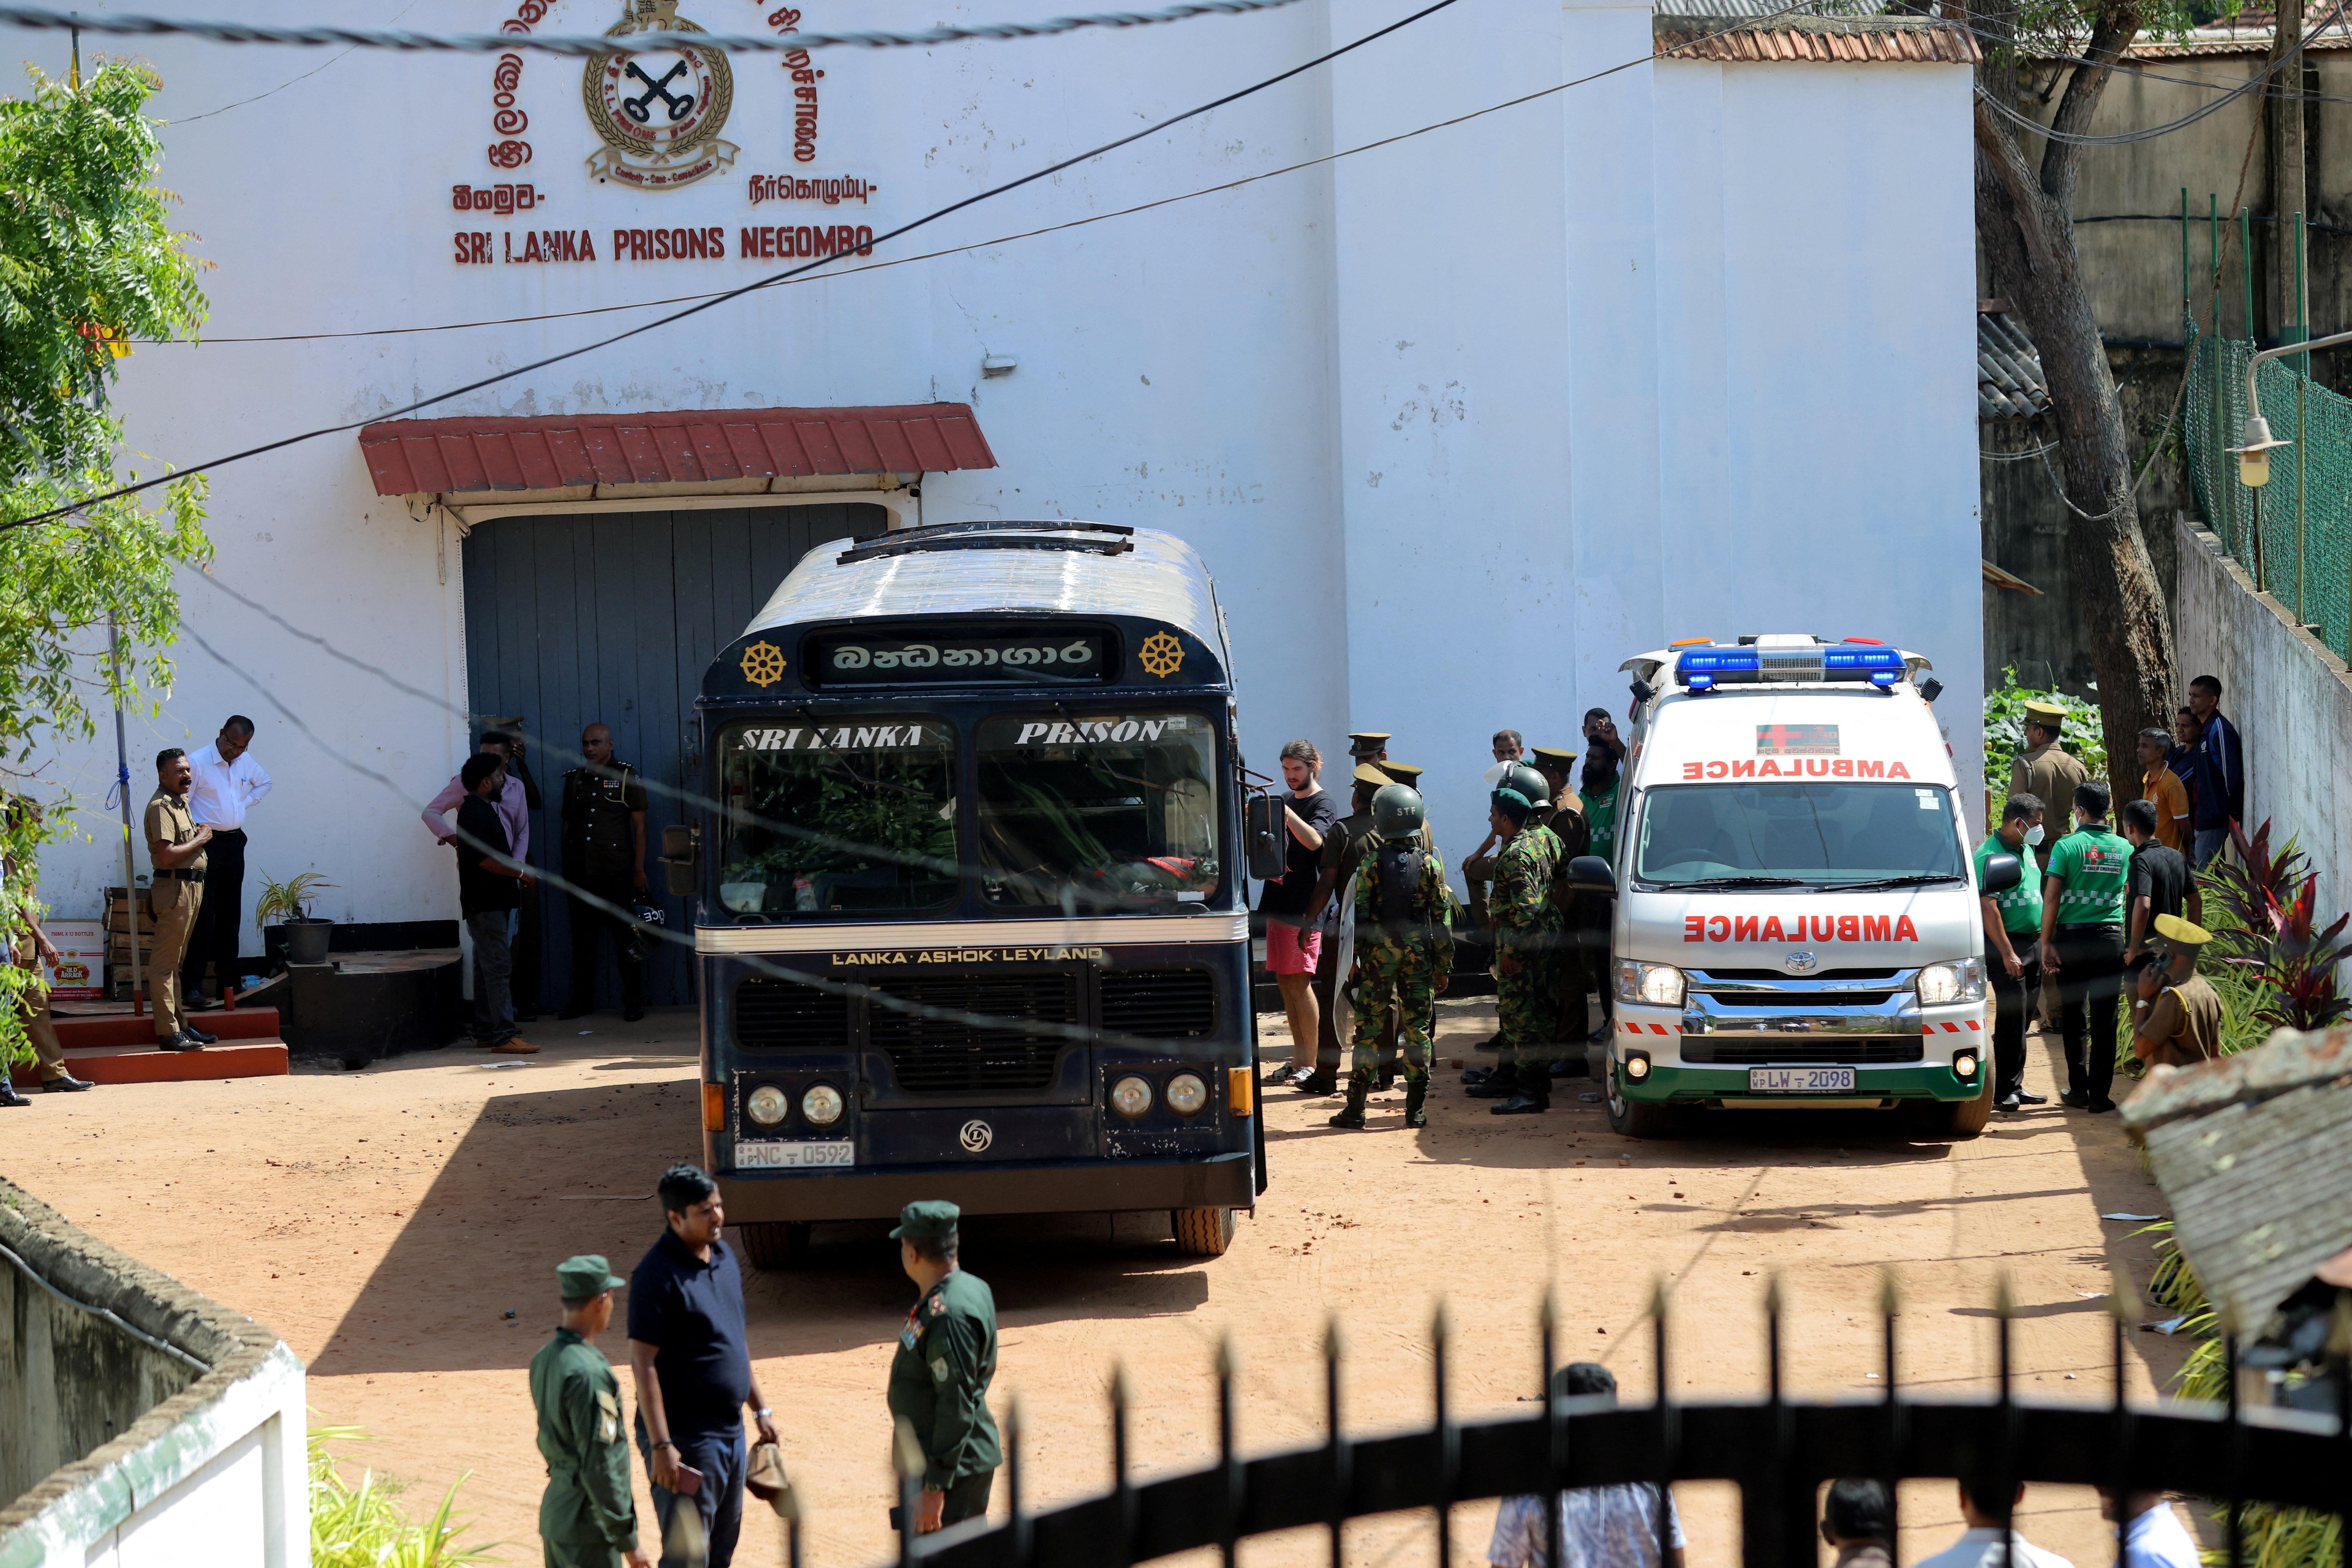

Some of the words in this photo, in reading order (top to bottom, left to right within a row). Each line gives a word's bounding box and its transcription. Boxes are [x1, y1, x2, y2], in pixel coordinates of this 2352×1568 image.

[615, 166, 644, 184] Custody
[454, 232, 492, 264] SRI
[505, 229, 597, 263] LANKA
[614, 227, 725, 261] PRISONS
[741, 225, 873, 258] NEGOMBO
[738, 728, 803, 750] SRI
[807, 725, 922, 750] LANKA
[1014, 720, 1167, 745] PRISON
[1397, 806, 1416, 816] STF
[644, 910, 665, 922] LICE
[832, 952, 908, 965] LANKA
[917, 949, 995, 963] ASHOK
[1003, 947, 1102, 961] LEYLAND
[1291, 938, 1300, 967] Calvin
[1752, 1079, 1765, 1088] WP
[1768, 1071, 1790, 1088] LW
[1809, 1071, 1850, 1087] 2098
[756, 1146, 781, 1164] NC
[803, 1145, 851, 1164] 0592
